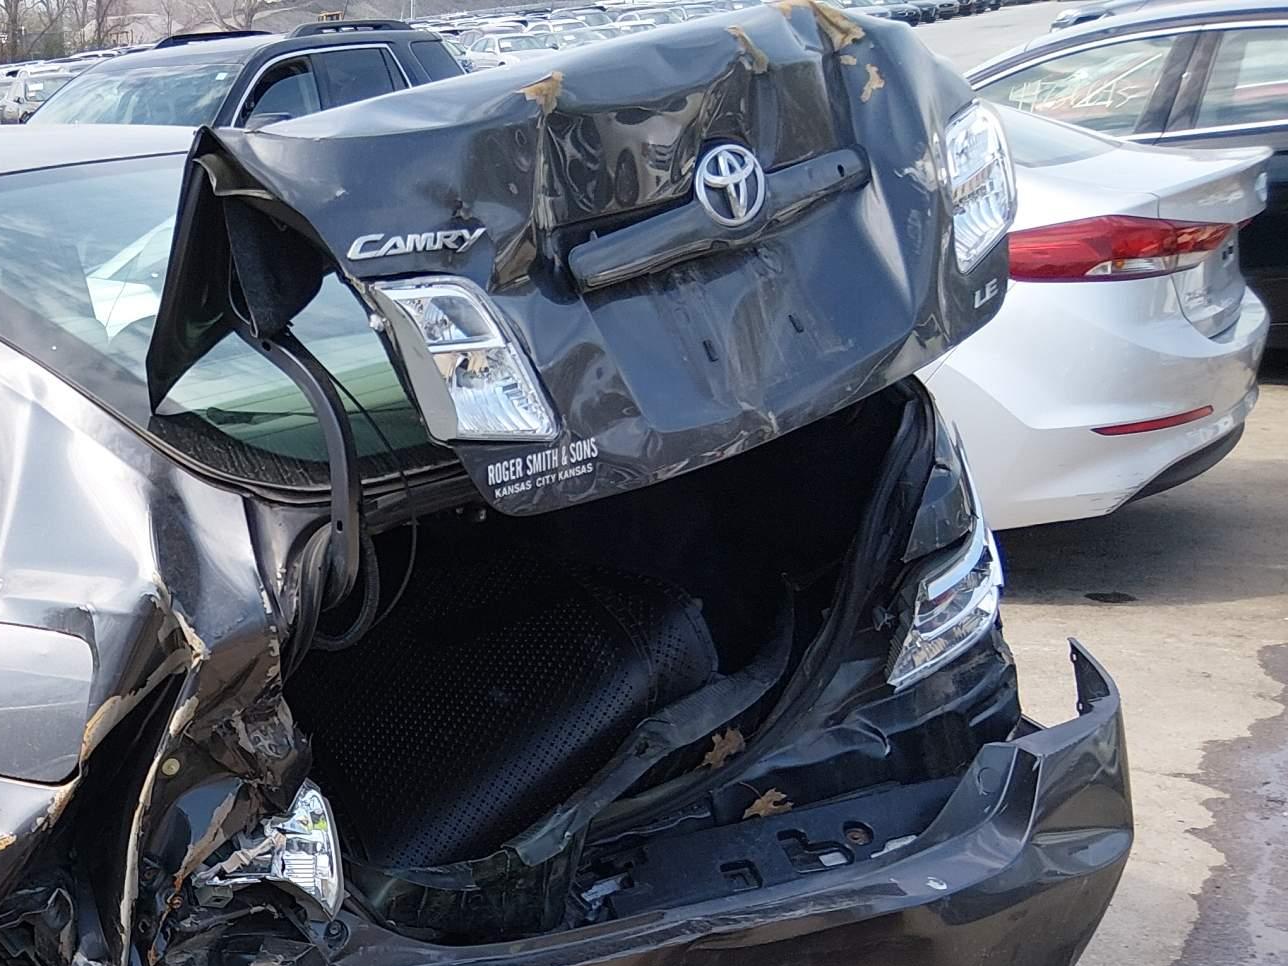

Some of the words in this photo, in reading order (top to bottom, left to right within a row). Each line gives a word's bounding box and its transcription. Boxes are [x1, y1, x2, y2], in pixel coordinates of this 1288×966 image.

[347, 228, 488, 261] CAMRY
[974, 278, 999, 309] LE
[487, 458, 523, 486] ROGER
[526, 448, 559, 476] SMITH
[561, 446, 568, 466] &
[569, 438, 599, 463] SONS
[494, 480, 532, 499] KANSAS
[536, 474, 557, 487] CITY
[558, 463, 594, 481] KANSAS
